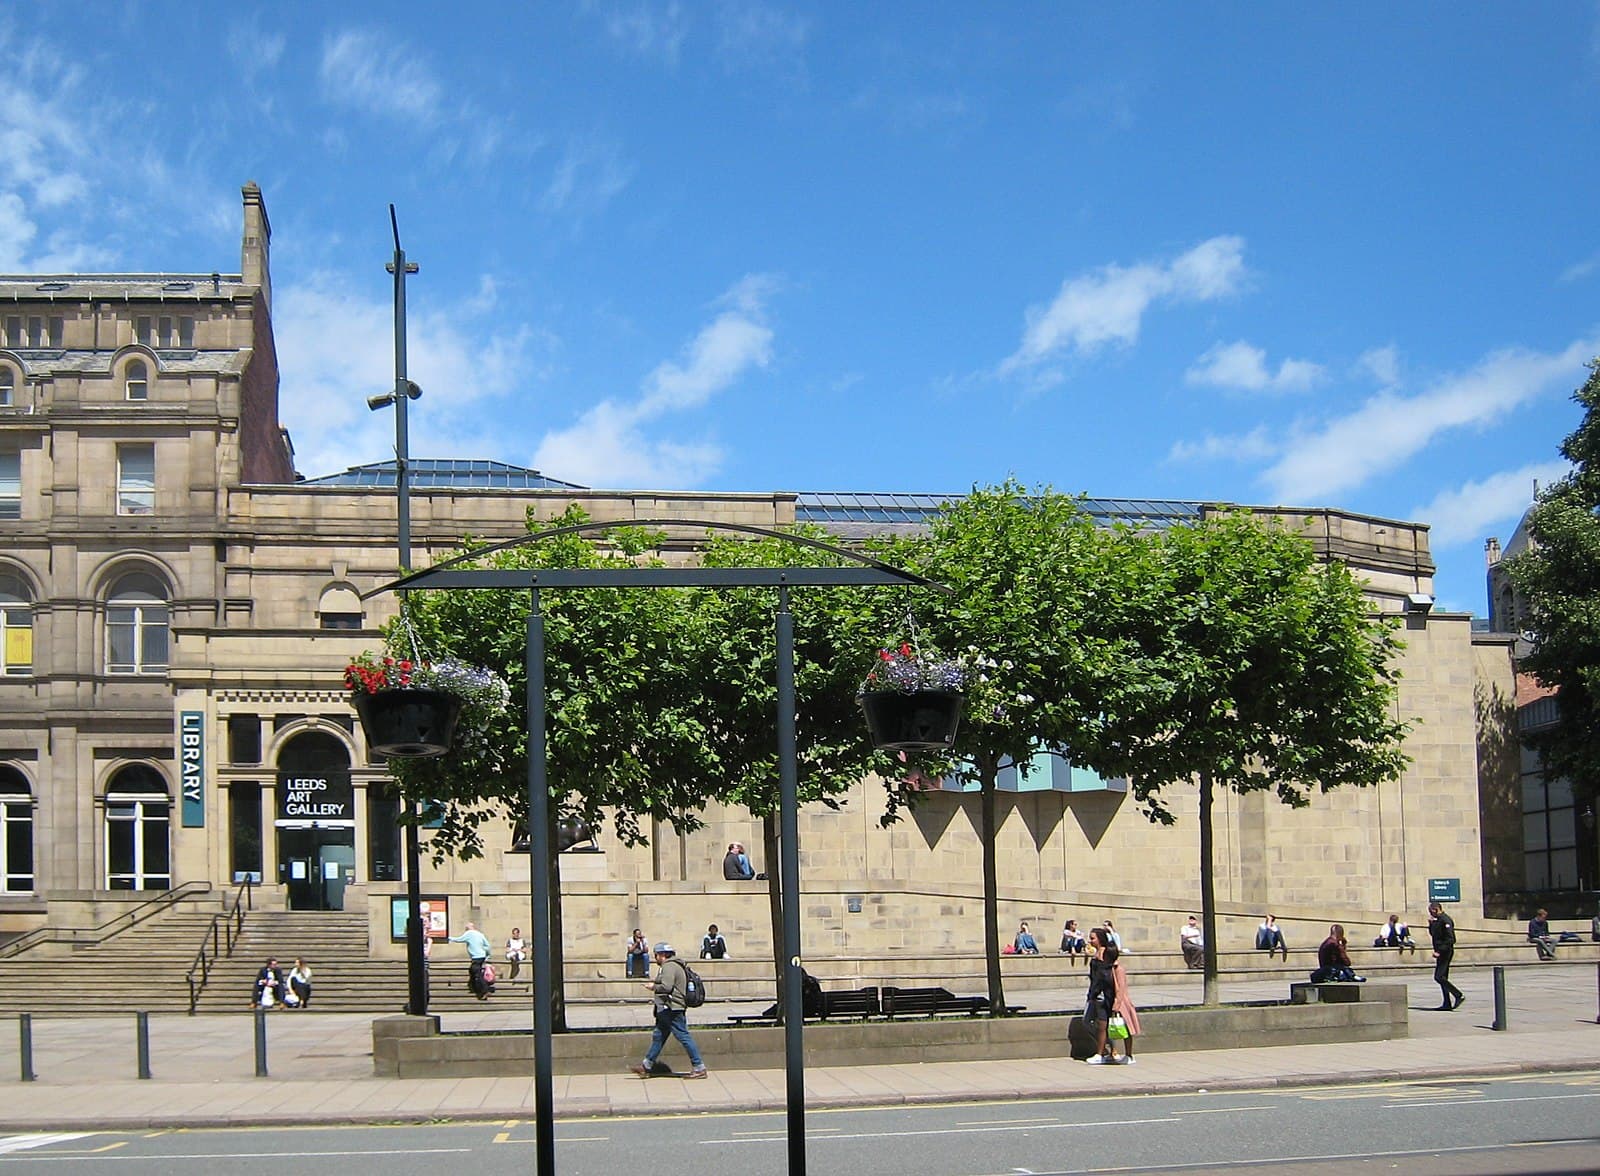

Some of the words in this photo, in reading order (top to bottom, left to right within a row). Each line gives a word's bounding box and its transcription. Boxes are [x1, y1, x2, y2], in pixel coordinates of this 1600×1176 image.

[183, 715, 201, 801] LIBRARY
[287, 779, 328, 790] LEEDS
[286, 791, 312, 802] ART
[286, 803, 345, 815] GALLERY
